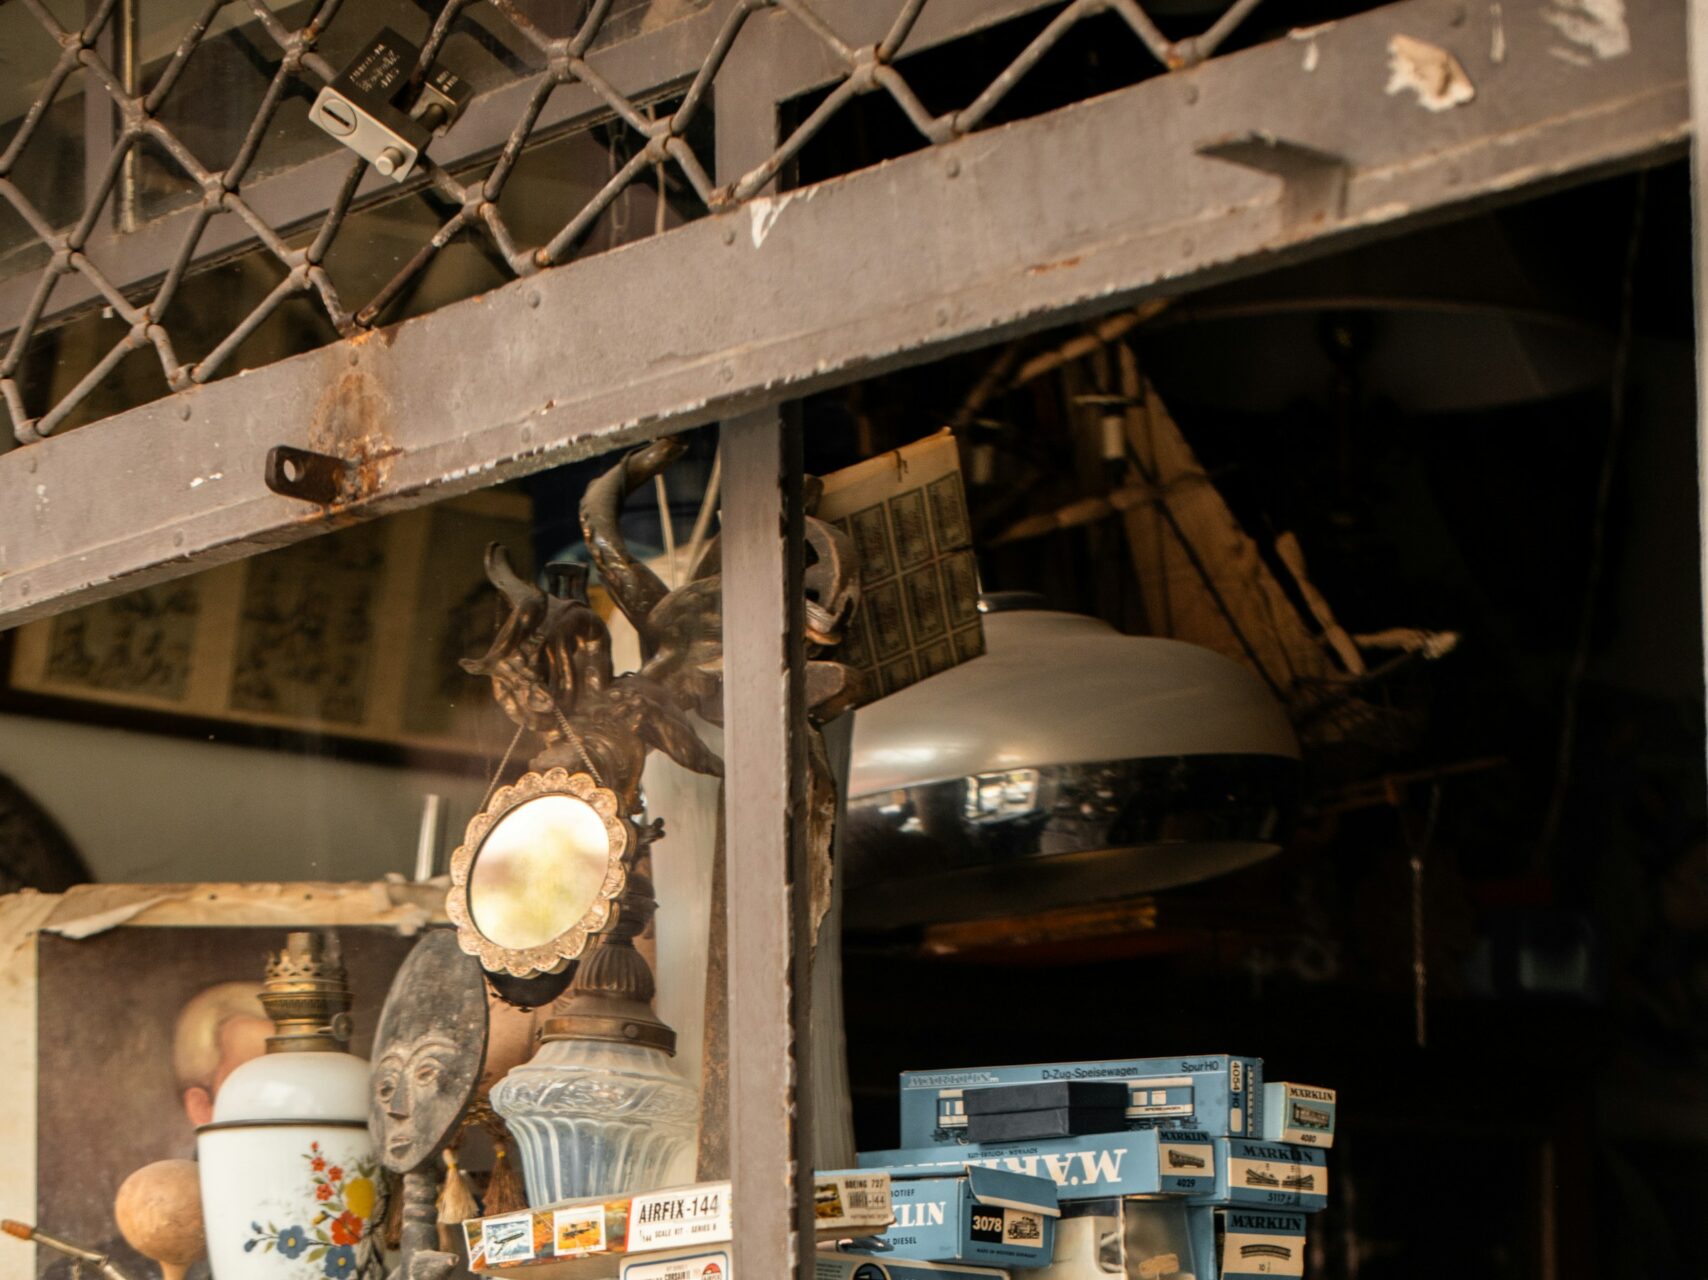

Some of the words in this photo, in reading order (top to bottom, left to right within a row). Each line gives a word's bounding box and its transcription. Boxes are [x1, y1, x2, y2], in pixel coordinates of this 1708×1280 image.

[1042, 1066, 1138, 1080] D-Zug-Speisewagen
[1232, 1062, 1241, 1091] 4054
[1177, 1178, 1196, 1188] 4029
[638, 1194, 719, 1224] AIRFIX-144
[972, 1215, 1003, 1232] 3078
[893, 1237, 917, 1245] DIESEL
